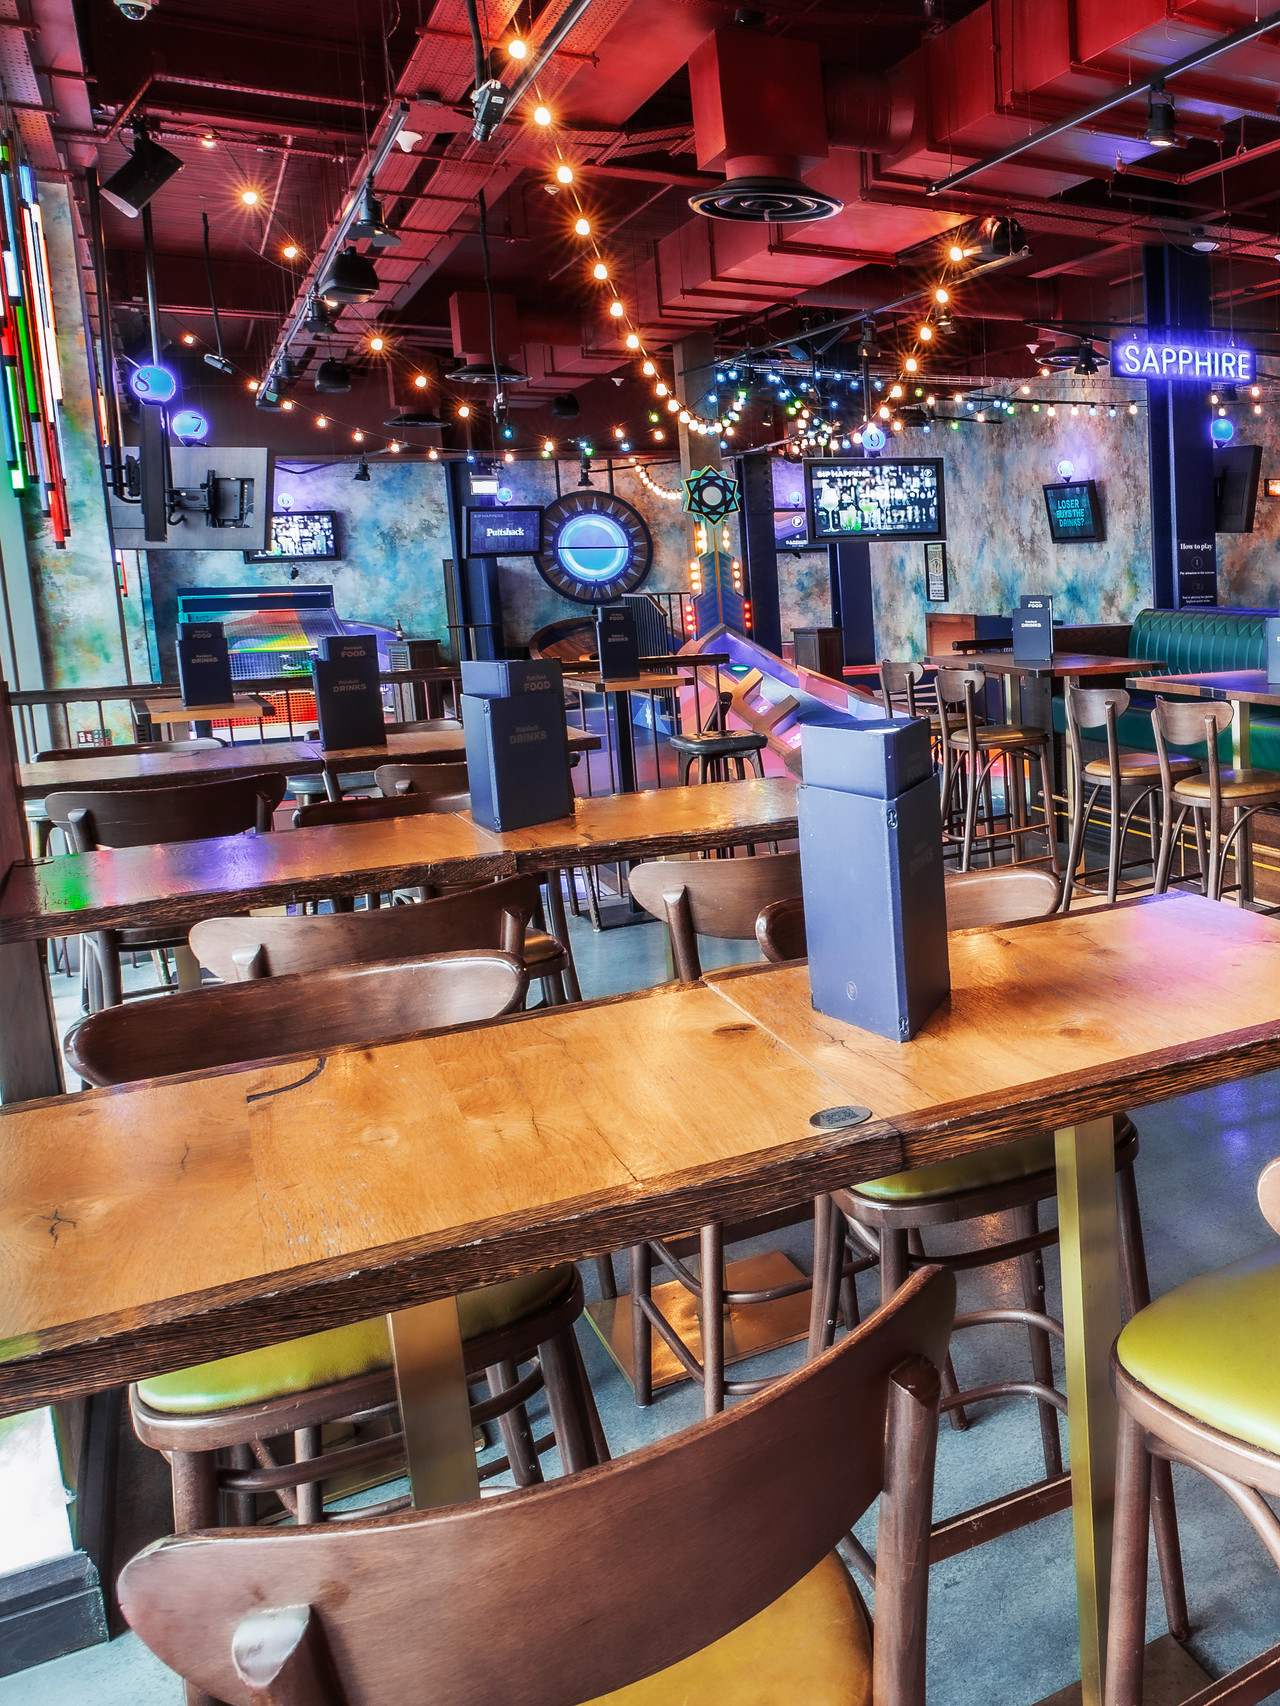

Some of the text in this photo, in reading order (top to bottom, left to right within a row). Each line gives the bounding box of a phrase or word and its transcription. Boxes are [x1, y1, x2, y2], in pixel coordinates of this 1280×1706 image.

[1125, 345, 1250, 380] SAPPHIRE
[134, 371, 150, 392] 8
[191, 416, 202, 432] 7
[870, 431, 880, 446] 9
[1058, 499, 1080, 509] LOSER
[1056, 509, 1085, 518] BUYS THE
[1060, 518, 1085, 527] DRINKS?
[486, 527, 524, 536] Puttshack
[1201, 543, 1213, 551] play
[341, 650, 366, 658] FOOD
[333, 684, 367, 693] DRINKS
[524, 682, 550, 692] FOOD
[509, 730, 547, 744] DRINKS
